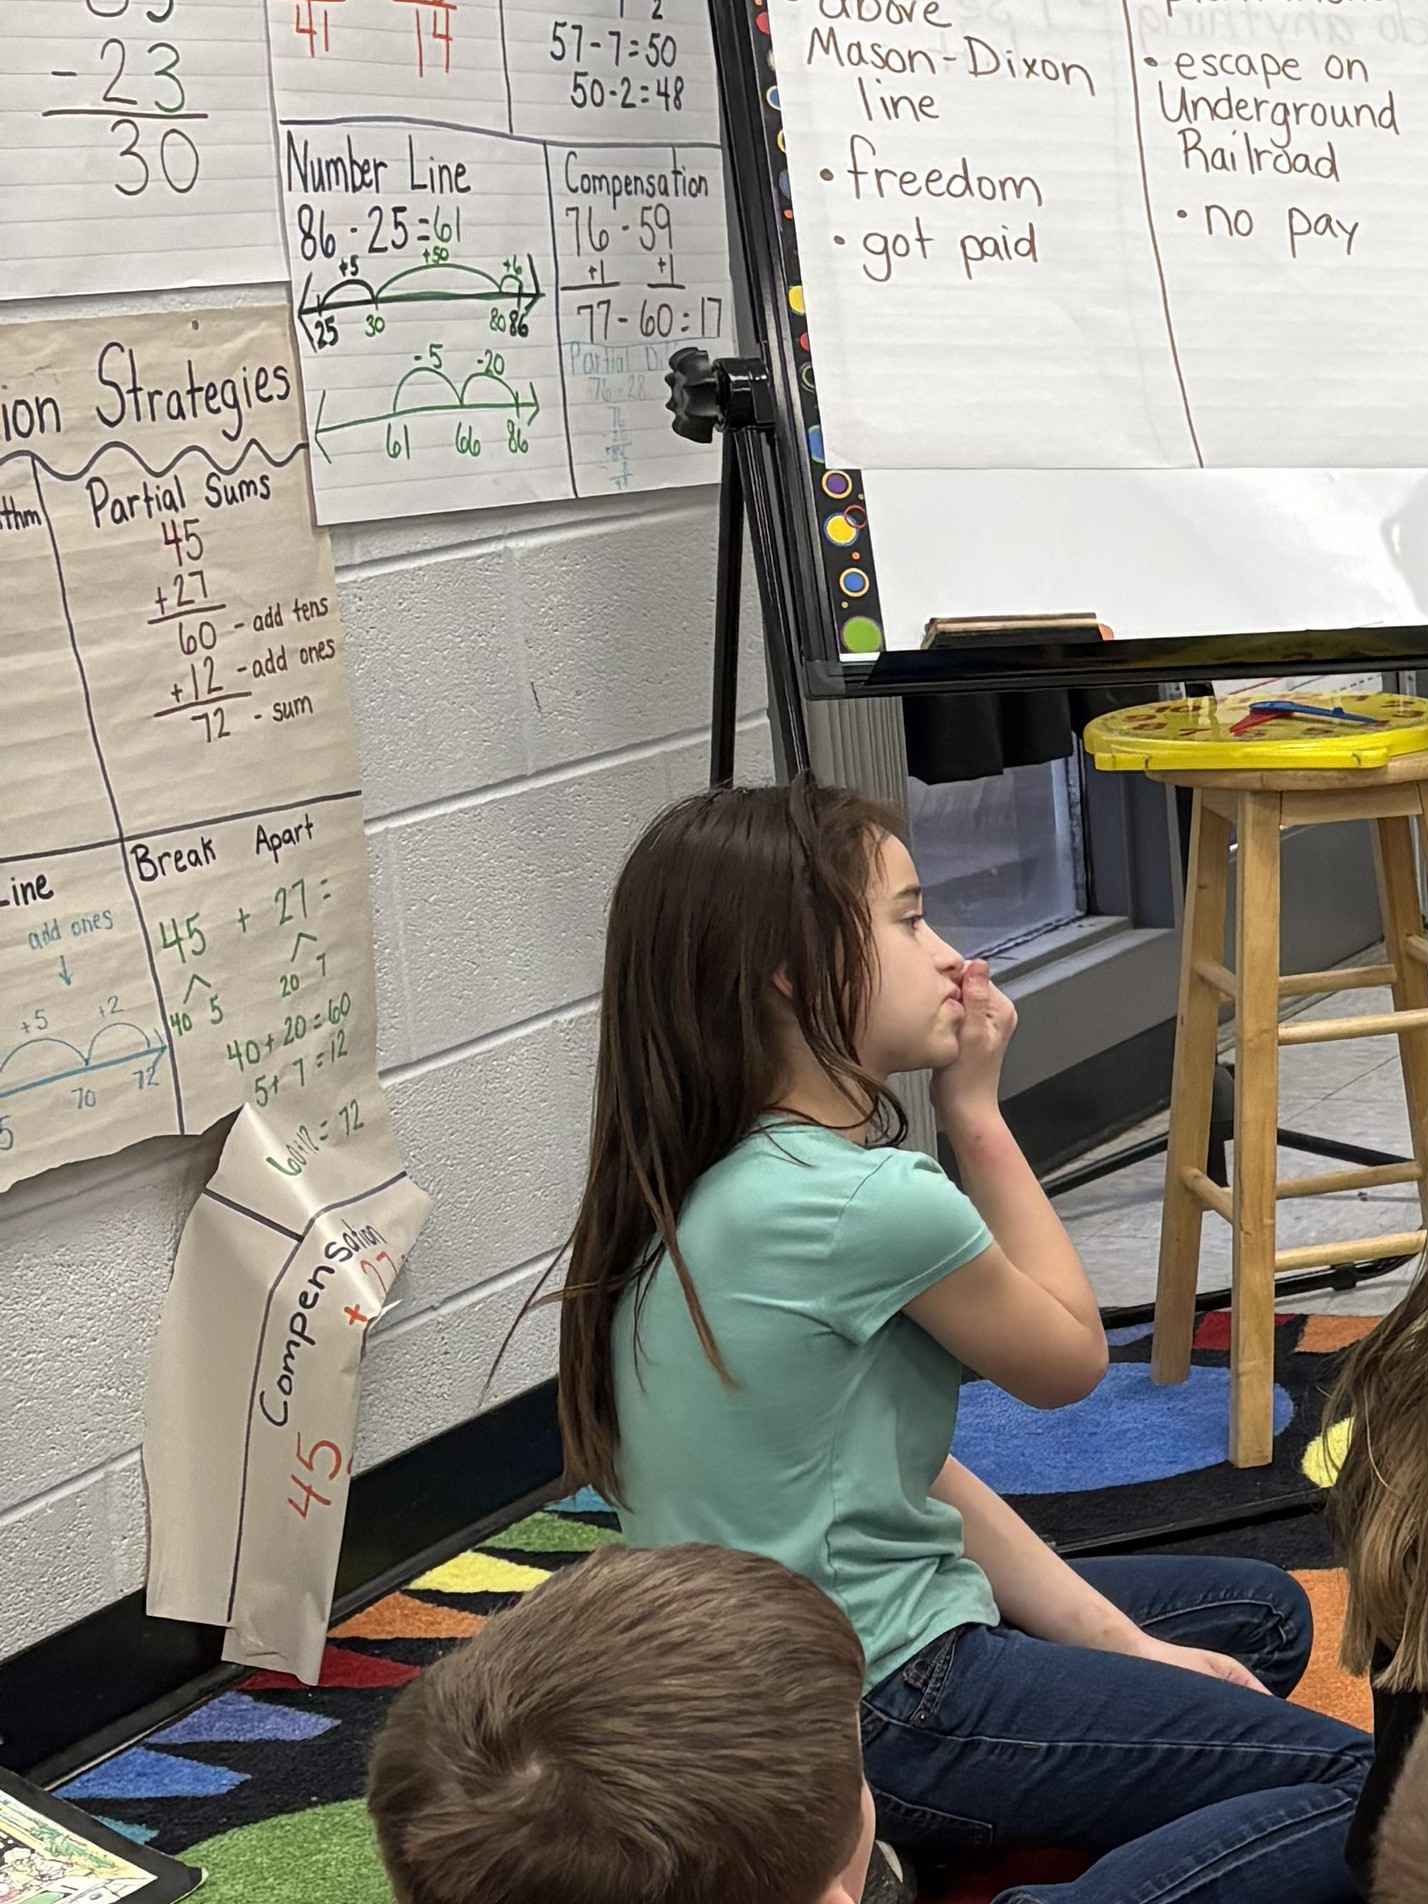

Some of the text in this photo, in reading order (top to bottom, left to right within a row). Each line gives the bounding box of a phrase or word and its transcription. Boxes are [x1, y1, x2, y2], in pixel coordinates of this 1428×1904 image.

[416, 8, 452, 77] 14
[806, 27, 1097, 96] Mason-Dixon
[861, 76, 940, 122] line
[1176, 51, 1369, 101] escape on
[1158, 83, 1400, 146] Underground
[111, 118, 199, 196] 30
[287, 131, 471, 194] Number Line
[565, 151, 709, 210] Compensation
[847, 132, 1044, 206] freedom
[1181, 129, 1340, 182] Railroad
[861, 220, 1038, 282] got paid
[1205, 206, 1359, 257] no pay
[364, 315, 385, 337] 30
[96, 341, 290, 441] Strategies
[86, 475, 185, 527] Partial
[205, 471, 271, 507] Sums
[162, 519, 203, 566] 45
[179, 596, 328, 655] 60 add tens
[300, 637, 335, 665] ones
[191, 697, 312, 743] 72 sum
[131, 814, 314, 882] Break Apart
[28, 909, 113, 951] add ones
[159, 912, 206, 964] 45
[260, 1217, 385, 1427] Compensation
